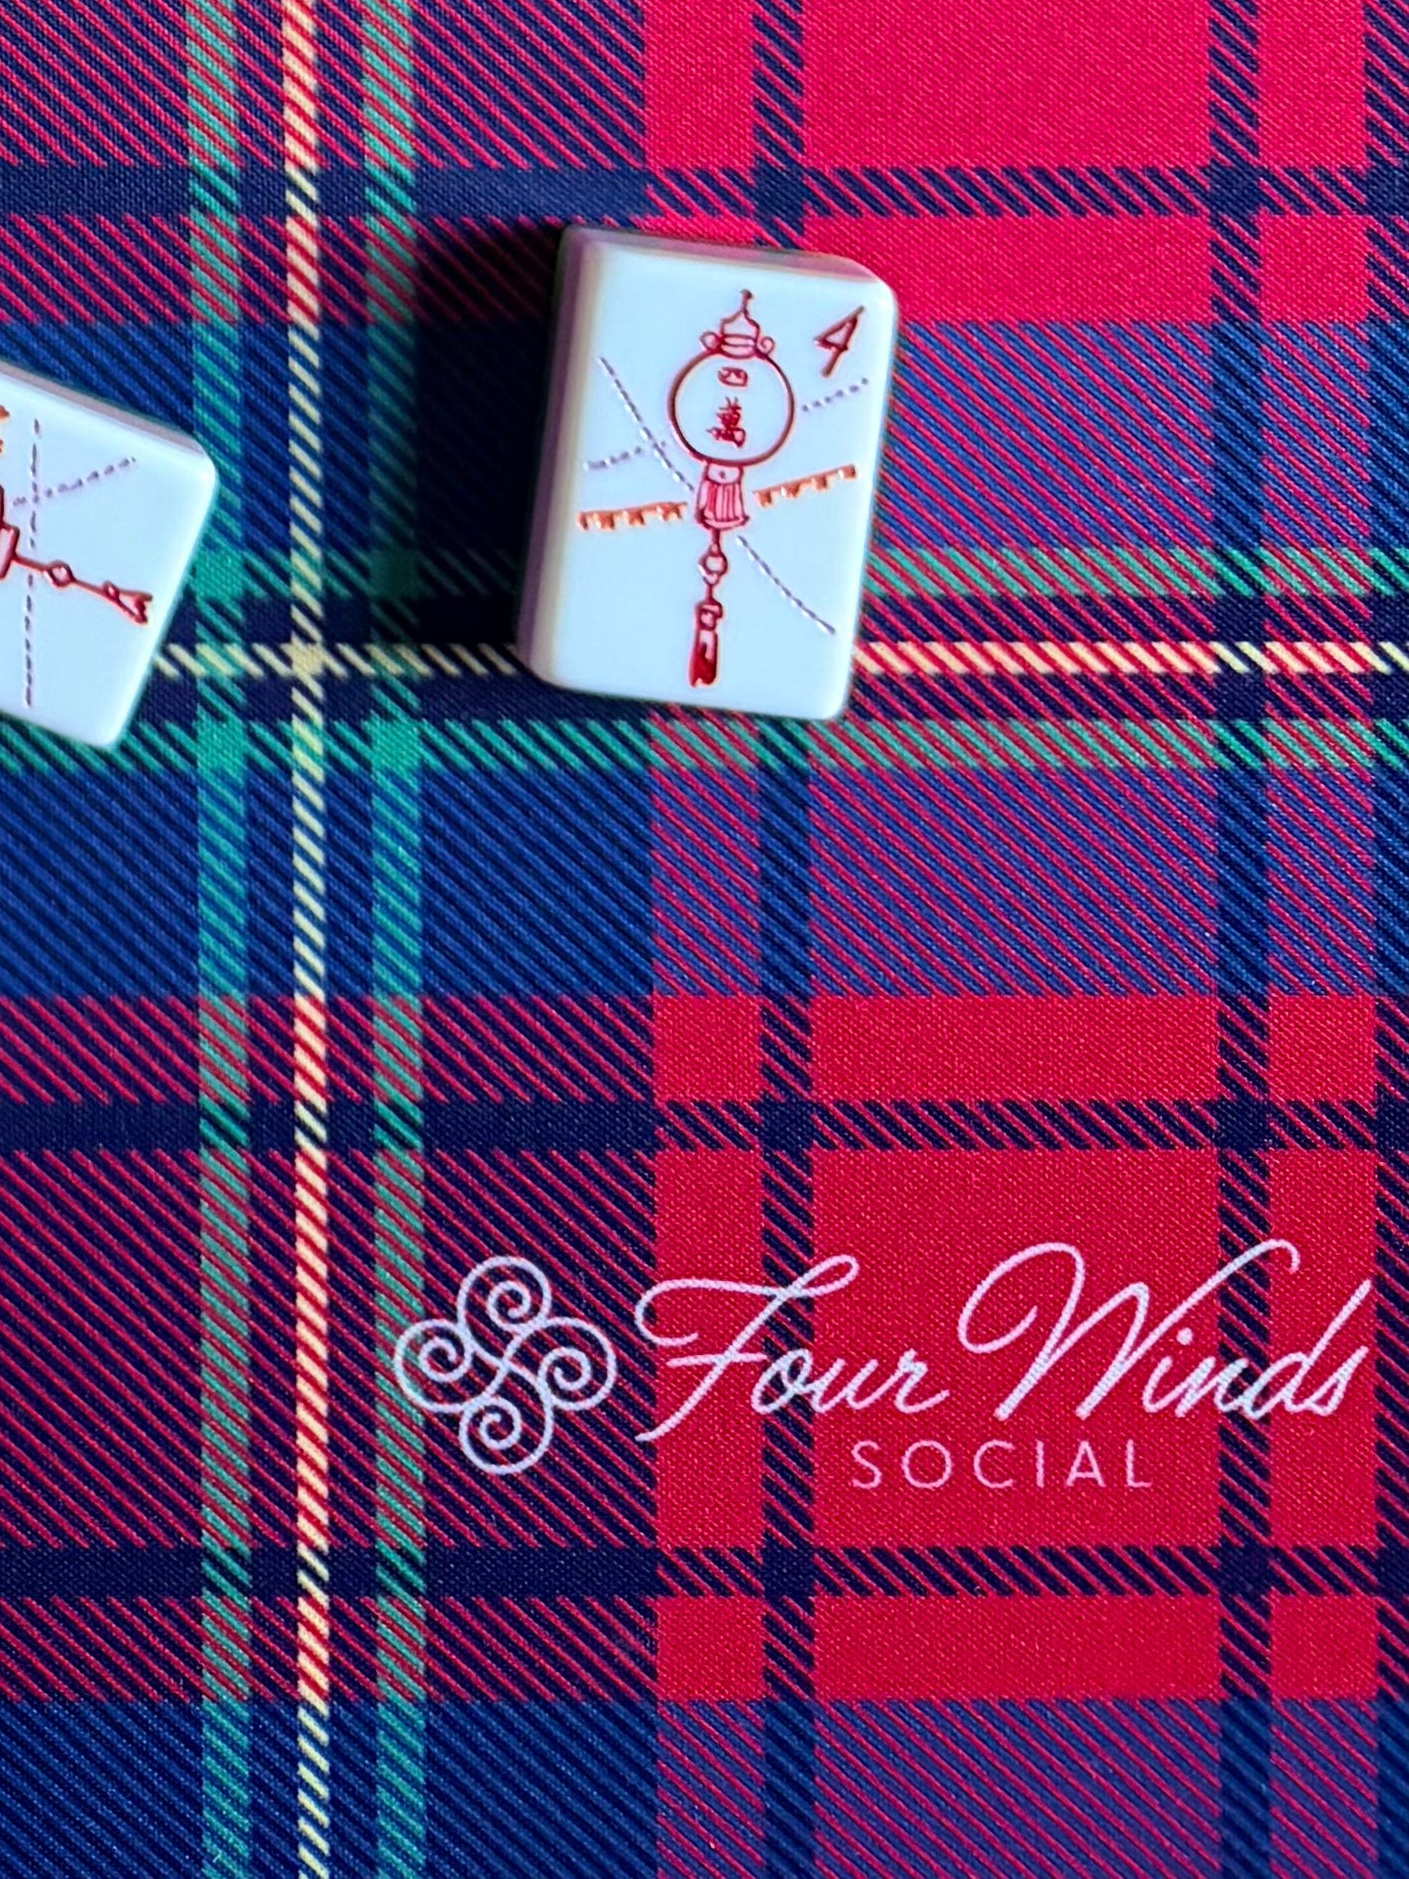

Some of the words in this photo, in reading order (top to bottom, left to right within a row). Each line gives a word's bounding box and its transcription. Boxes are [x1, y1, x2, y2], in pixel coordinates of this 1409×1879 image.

[814, 306, 865, 378] 4
[634, 1253, 951, 1443] Four
[957, 1239, 1373, 1421] Winds
[850, 1439, 1154, 1490] SOCIAL
